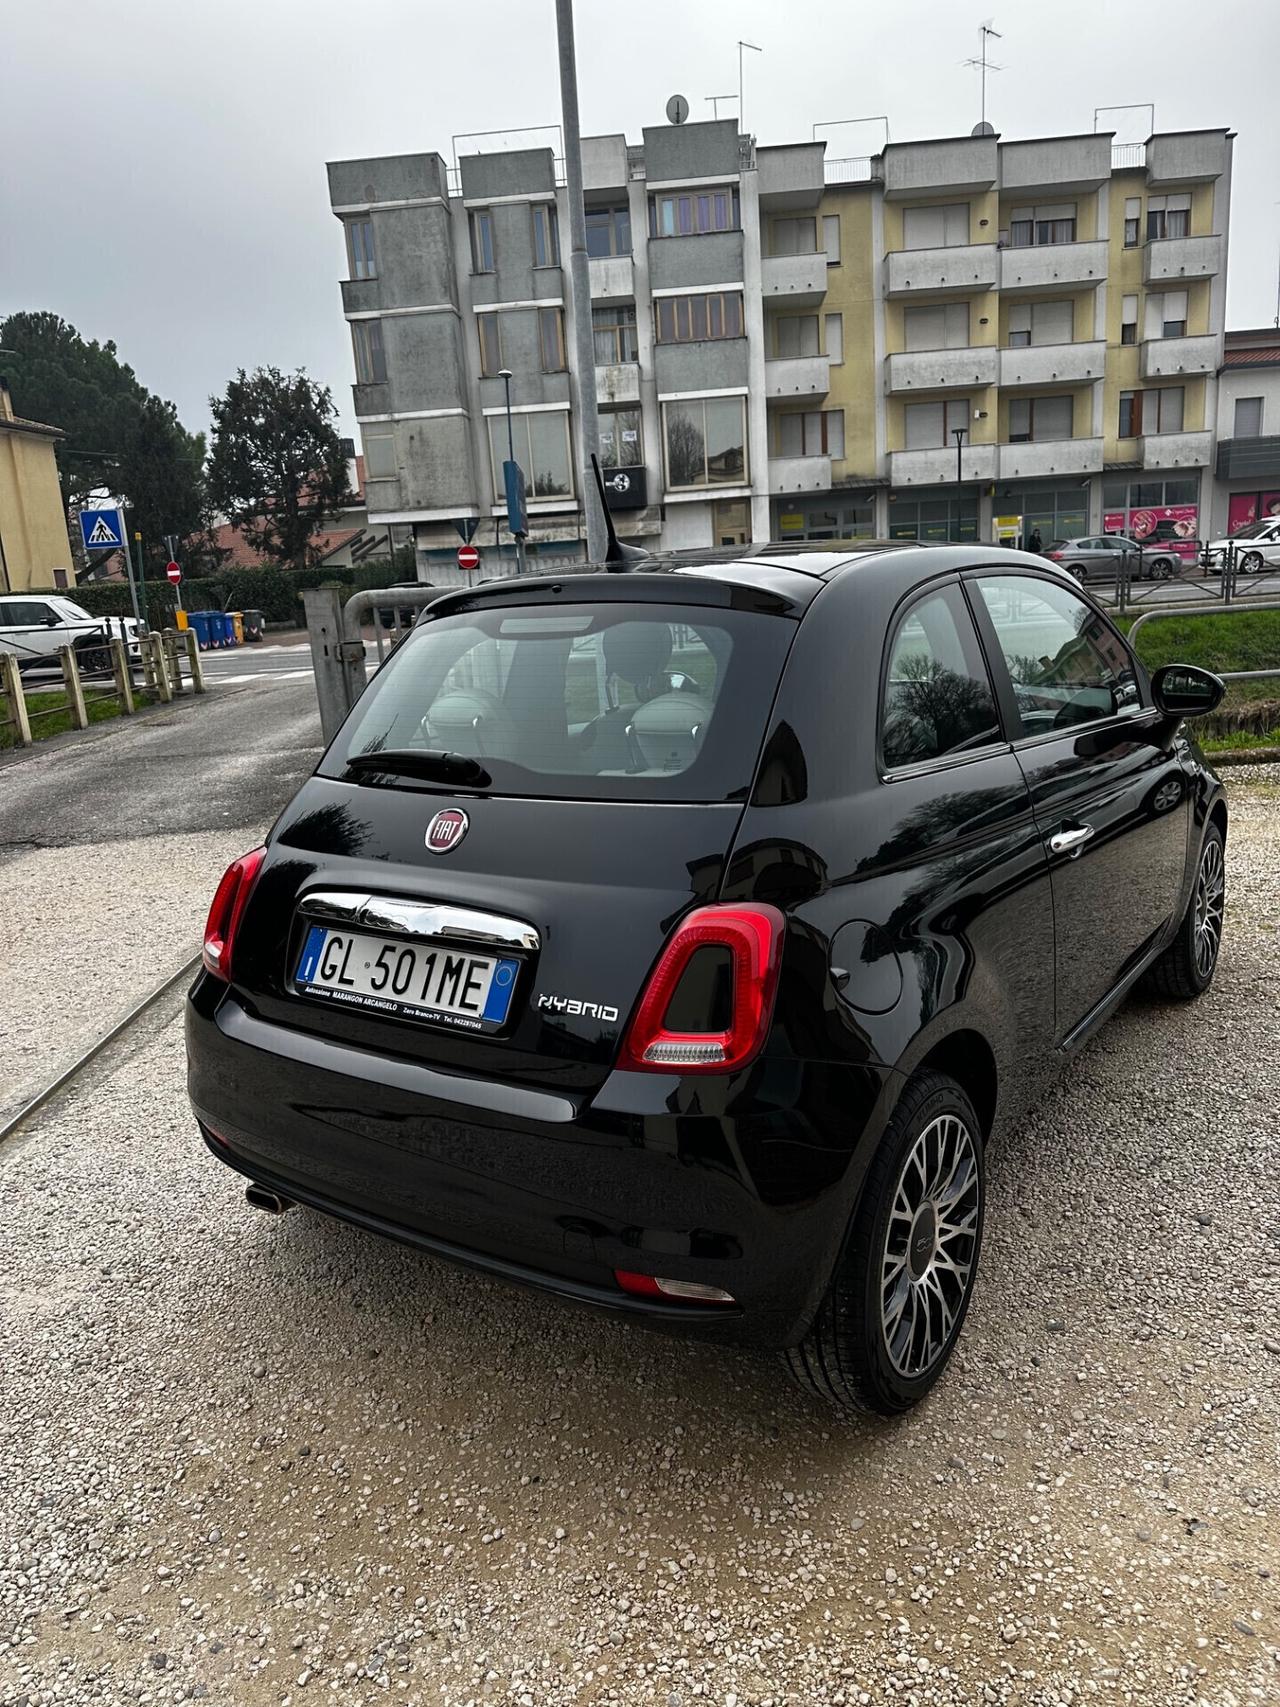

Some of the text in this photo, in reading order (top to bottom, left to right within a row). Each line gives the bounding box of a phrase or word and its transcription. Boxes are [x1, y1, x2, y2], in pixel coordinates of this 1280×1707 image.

[432, 820, 460, 841] FIAT
[320, 936, 489, 1011] GL 501ME
[332, 991, 363, 1003] MARANGON
[363, 998, 398, 1011] ARCANGELO
[538, 993, 619, 1022] HYBRID
